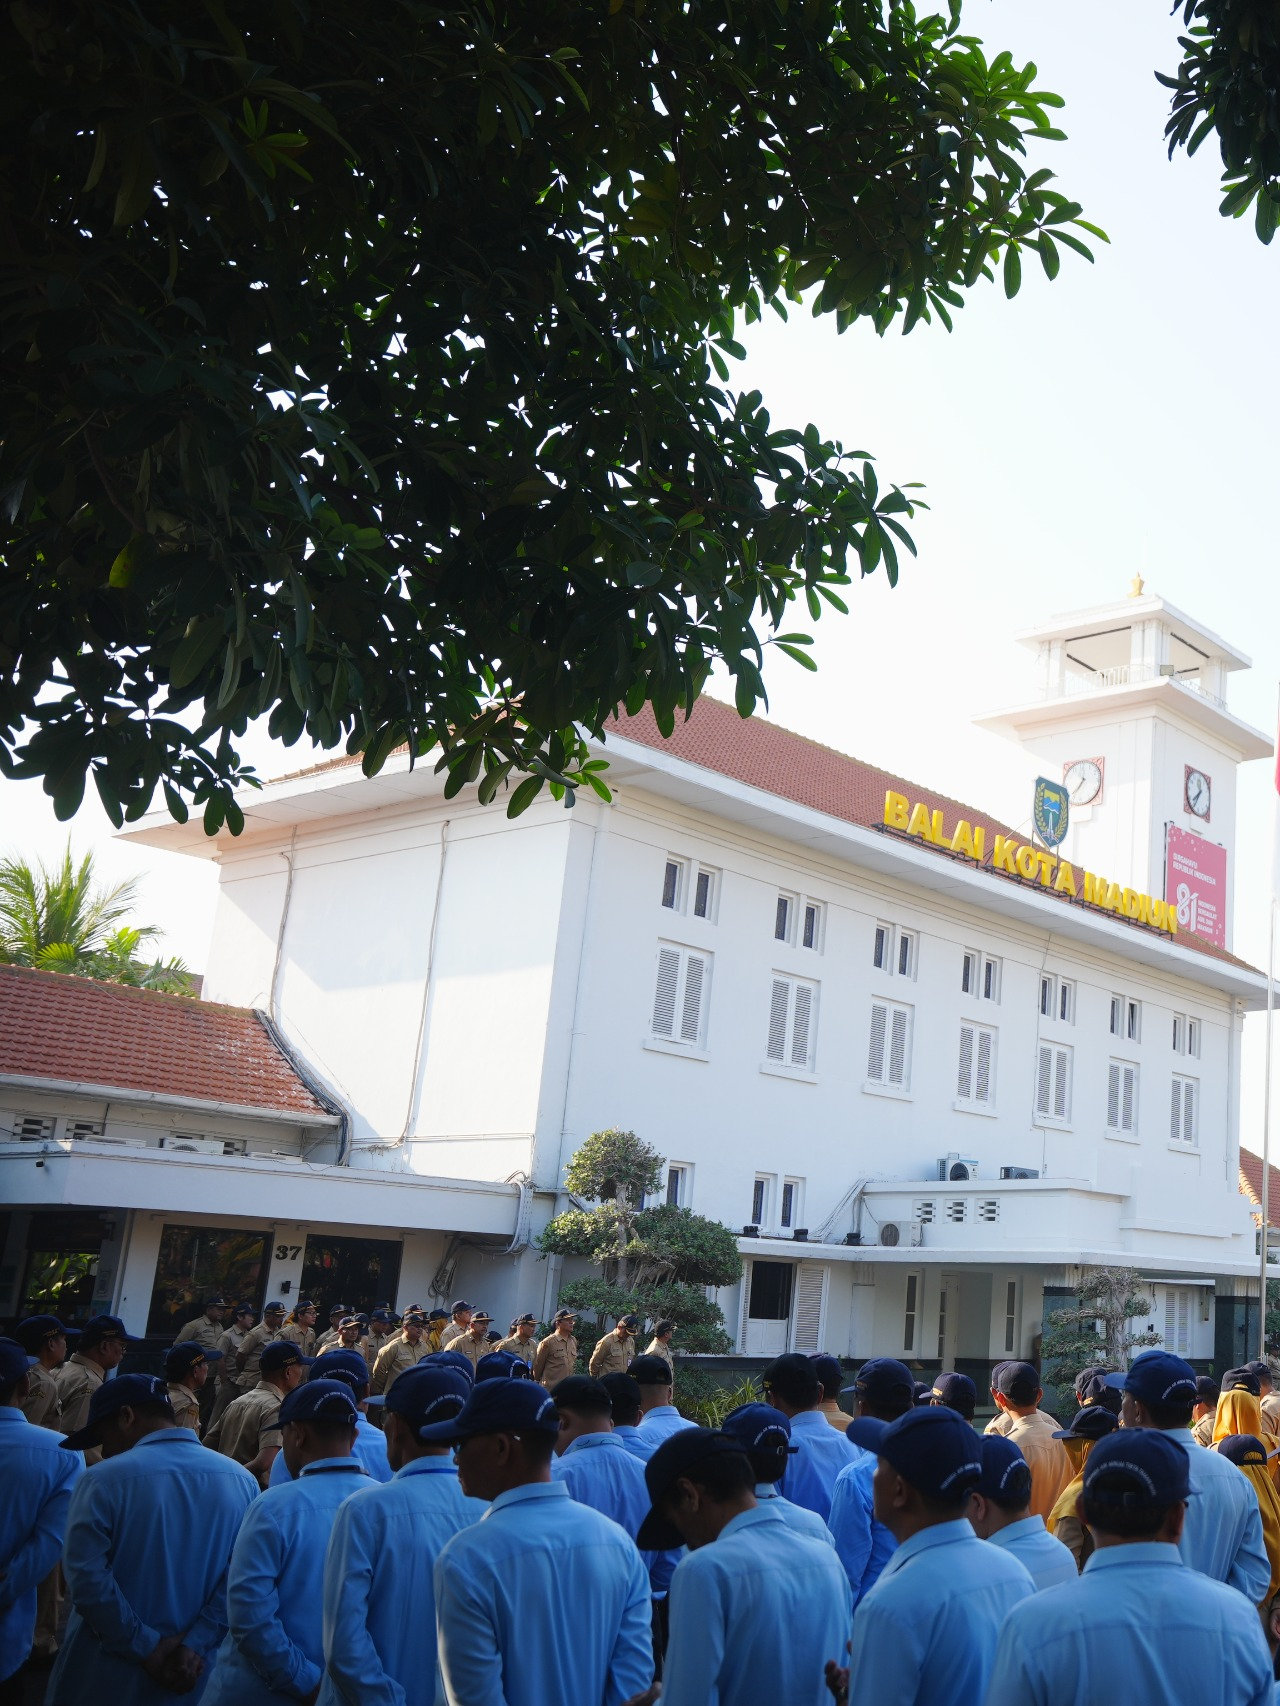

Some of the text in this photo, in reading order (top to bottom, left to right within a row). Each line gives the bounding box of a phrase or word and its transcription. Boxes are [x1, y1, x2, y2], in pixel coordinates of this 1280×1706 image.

[884, 790, 1178, 934] BALAI KOTA MADIUN
[275, 1244, 303, 1260] 37
